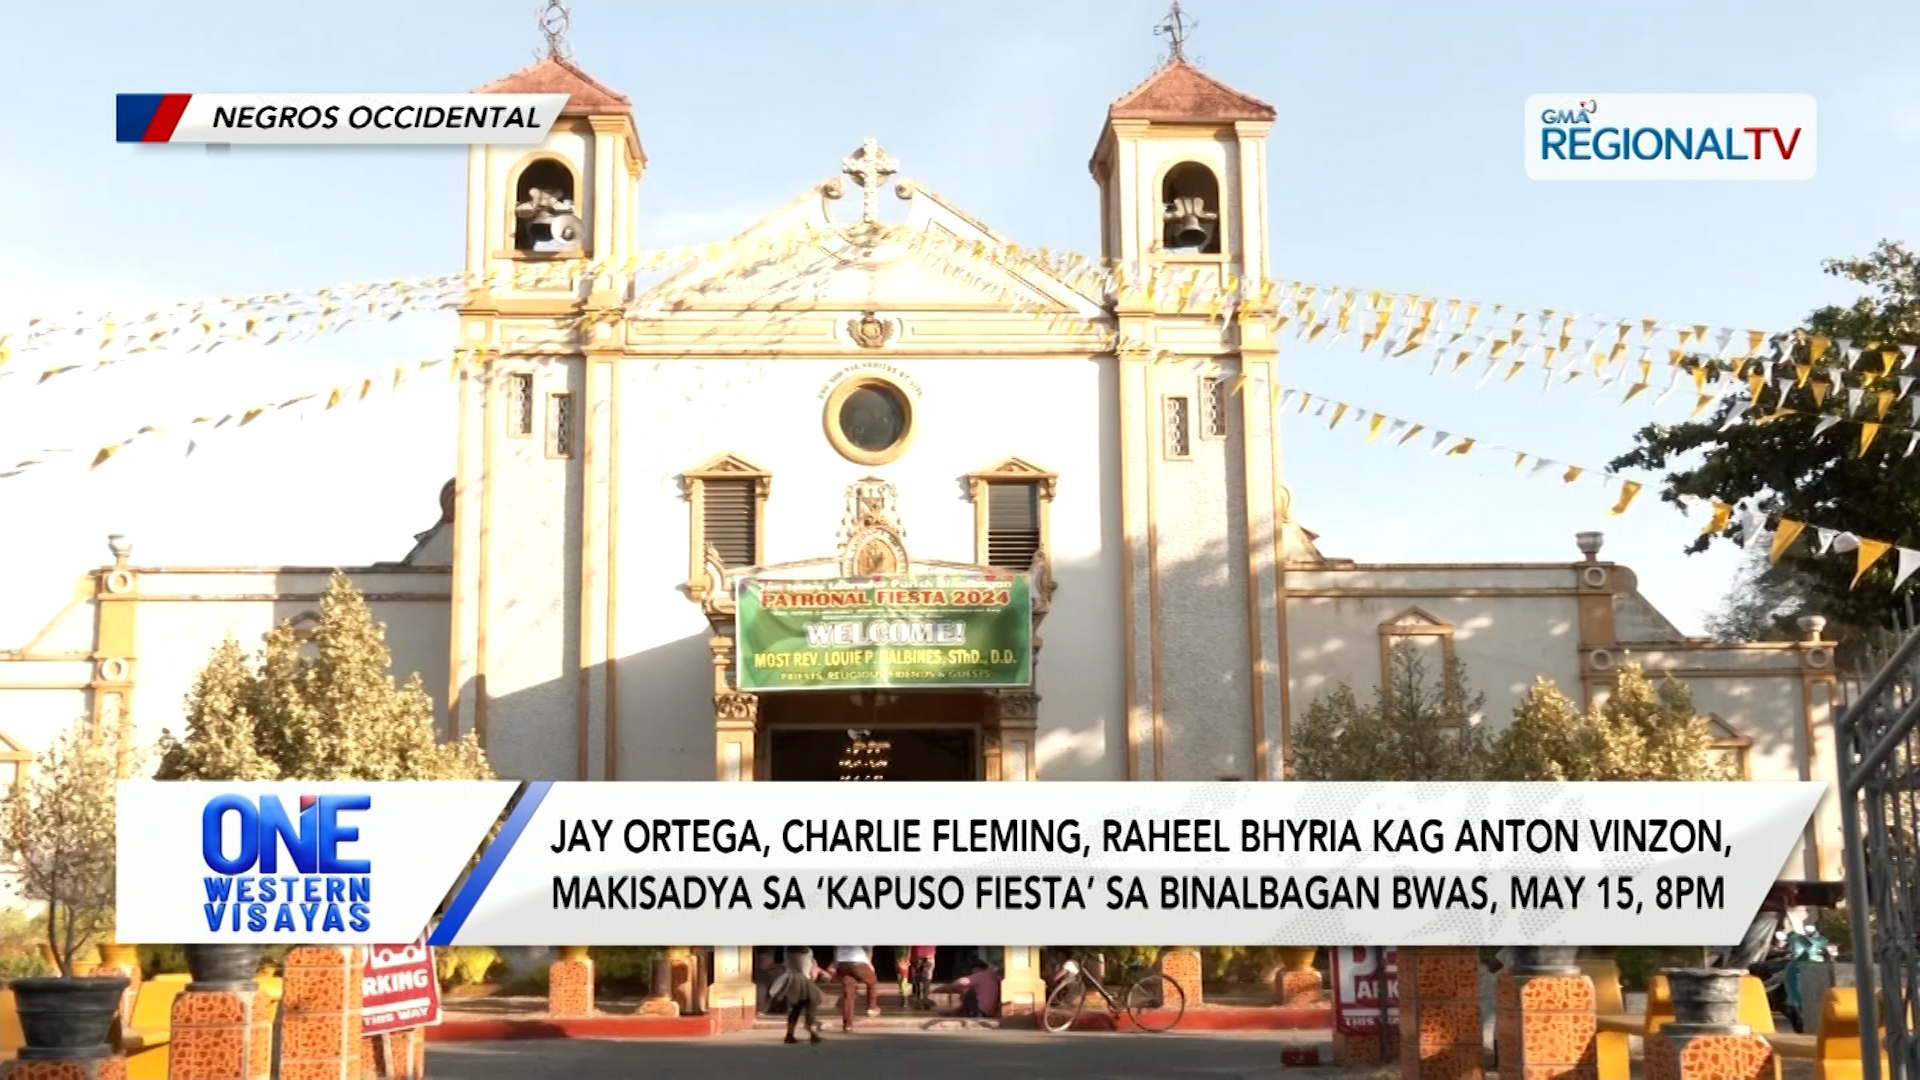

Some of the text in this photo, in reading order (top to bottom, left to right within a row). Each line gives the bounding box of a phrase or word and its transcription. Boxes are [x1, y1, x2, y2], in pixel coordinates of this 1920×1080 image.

[760, 589, 1010, 608] PATRONAL FIESTA 2024
[804, 620, 966, 648] WELCOME!
[754, 652, 791, 668] MOST
[793, 651, 822, 667] REV.
[824, 650, 862, 666] LOUIE
[397, 1007, 429, 1020] WAY
